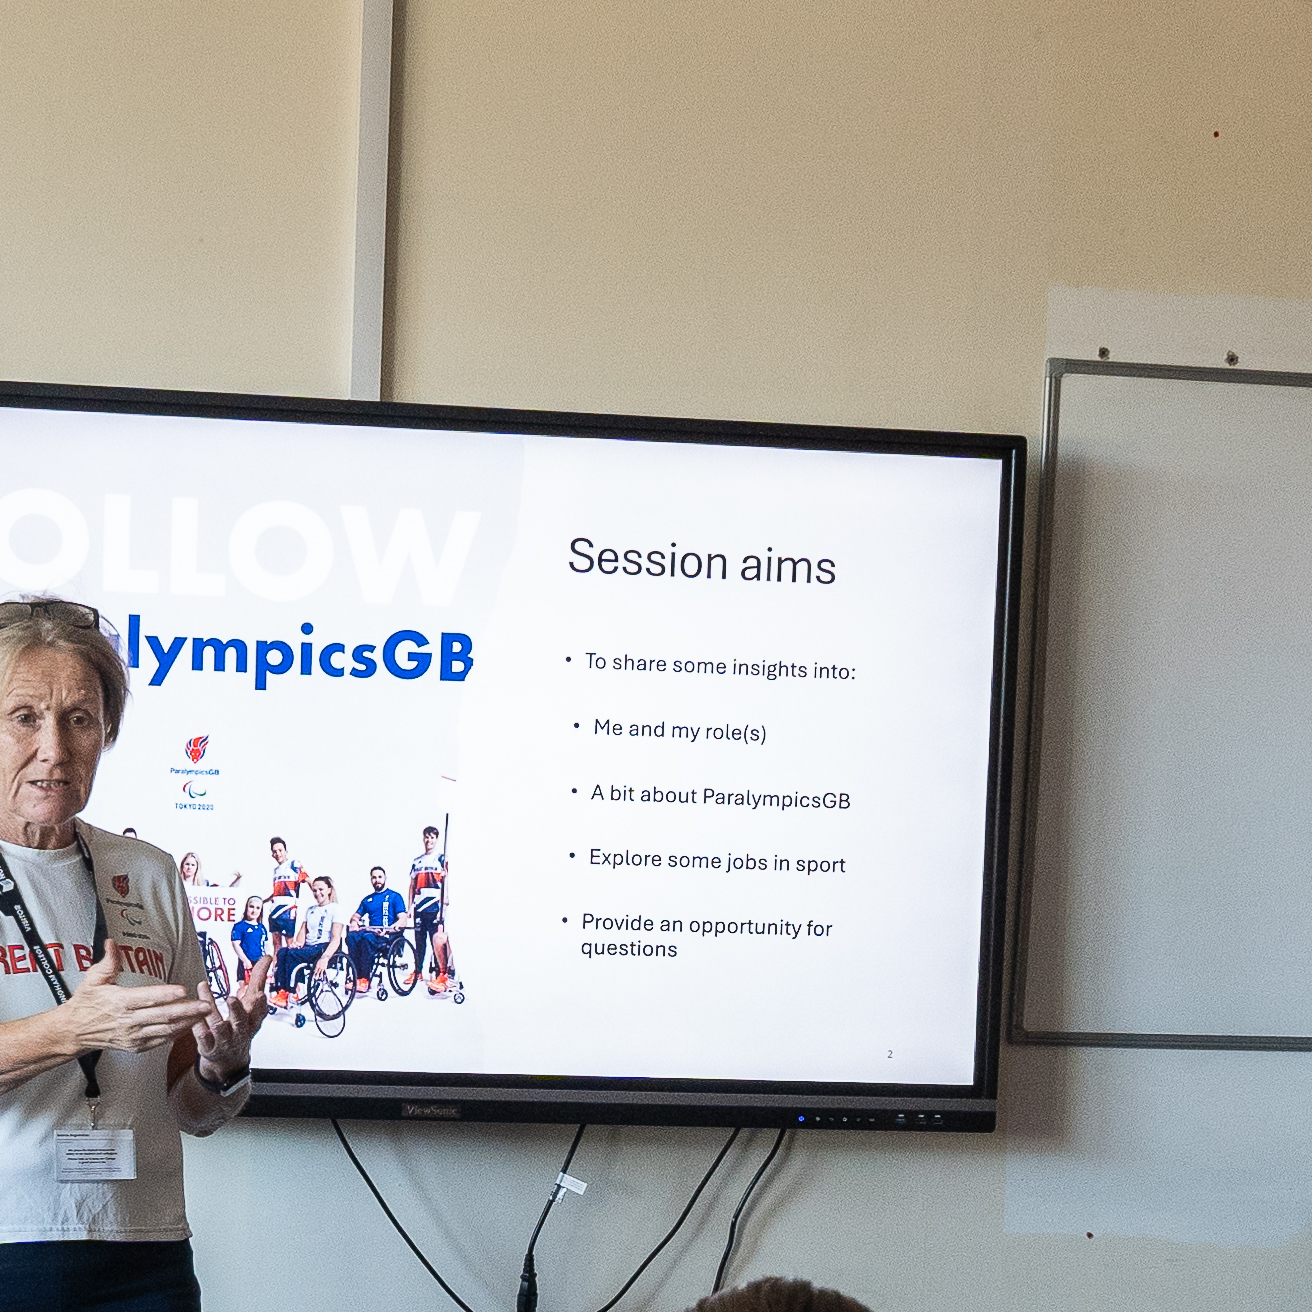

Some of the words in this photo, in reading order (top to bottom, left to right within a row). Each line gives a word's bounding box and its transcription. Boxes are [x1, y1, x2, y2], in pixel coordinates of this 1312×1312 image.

[568, 537, 727, 582] Session
[740, 547, 837, 586] aims
[585, 652, 609, 671] To
[613, 654, 668, 673] share
[672, 658, 727, 675] some
[733, 657, 808, 682] insights
[813, 661, 856, 680] into:
[594, 719, 622, 738] Me
[628, 720, 666, 740] and
[671, 725, 700, 743] my
[705, 723, 767, 745] role(s)
[591, 784, 605, 802] A
[609, 784, 635, 803] bit
[640, 786, 697, 805] about
[702, 788, 851, 812] ParalympicsGB
[589, 849, 662, 872] Explore
[667, 854, 722, 871] some
[725, 853, 768, 875] jobs
[773, 854, 790, 872] in
[795, 856, 847, 877] sport
[188, 896, 220, 905] SSIBLE
[223, 897, 236, 906] TO
[14, 904, 31, 932] VISITOR
[581, 913, 655, 934] Provide
[659, 917, 684, 933] an
[689, 918, 802, 940] opportunity
[806, 919, 833, 937] for
[580, 938, 678, 960] questions
[73, 944, 168, 983] BTAIN
[887, 1049, 893, 1060] 2
